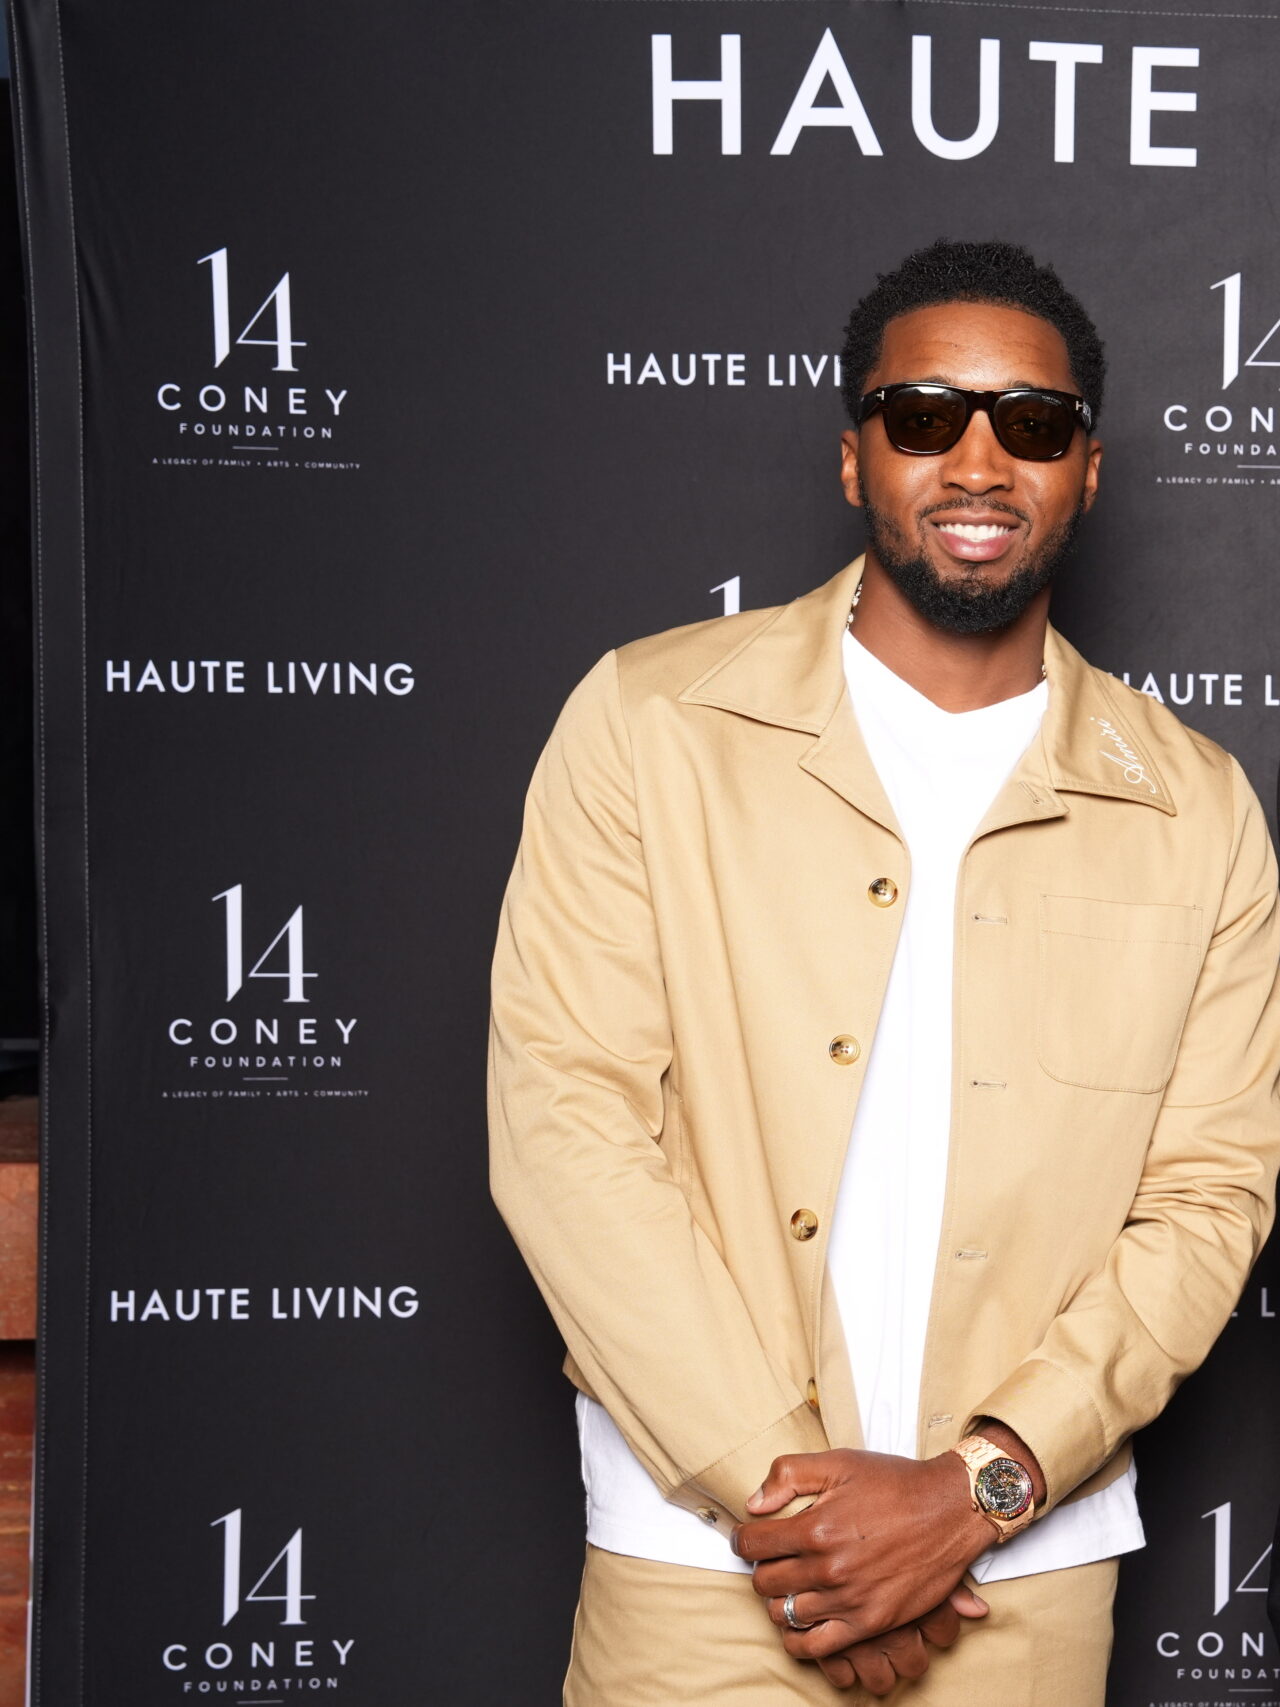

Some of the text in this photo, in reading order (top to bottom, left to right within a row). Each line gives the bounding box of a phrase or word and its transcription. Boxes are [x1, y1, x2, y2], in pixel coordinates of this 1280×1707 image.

[651, 27, 1200, 168] HAUTE
[196, 246, 308, 373] 14
[606, 352, 842, 388] HAUTE LIVI
[157, 383, 348, 416] CONEY
[179, 422, 332, 439] FOUNDATION
[162, 458, 198, 466] LEGACY
[218, 459, 252, 468] FAMILY
[266, 460, 290, 469] ARTS
[304, 461, 361, 470] COMMUNITY
[1166, 476, 1202, 484] LEGACY
[1206, 477, 1218, 485] OF
[1222, 477, 1256, 486] FAMILY
[106, 659, 415, 696] HAUTE LIVING
[211, 883, 319, 1003] 14
[168, 1017, 358, 1046] CONEY
[189, 1055, 342, 1069] FOUNDATION
[172, 1090, 208, 1098] LEGACY
[211, 1090, 224, 1098] OF
[228, 1090, 261, 1098] FAMILY
[313, 1089, 369, 1097] COMMUNITY
[110, 1285, 420, 1323] HAUTE LIVING
[210, 1507, 317, 1627] 14
[162, 1638, 355, 1671] CONEY
[1156, 1631, 1265, 1658] CON
[183, 1677, 338, 1693] FOUNDATION
[1176, 1668, 1280, 1680] FOUNDAT
